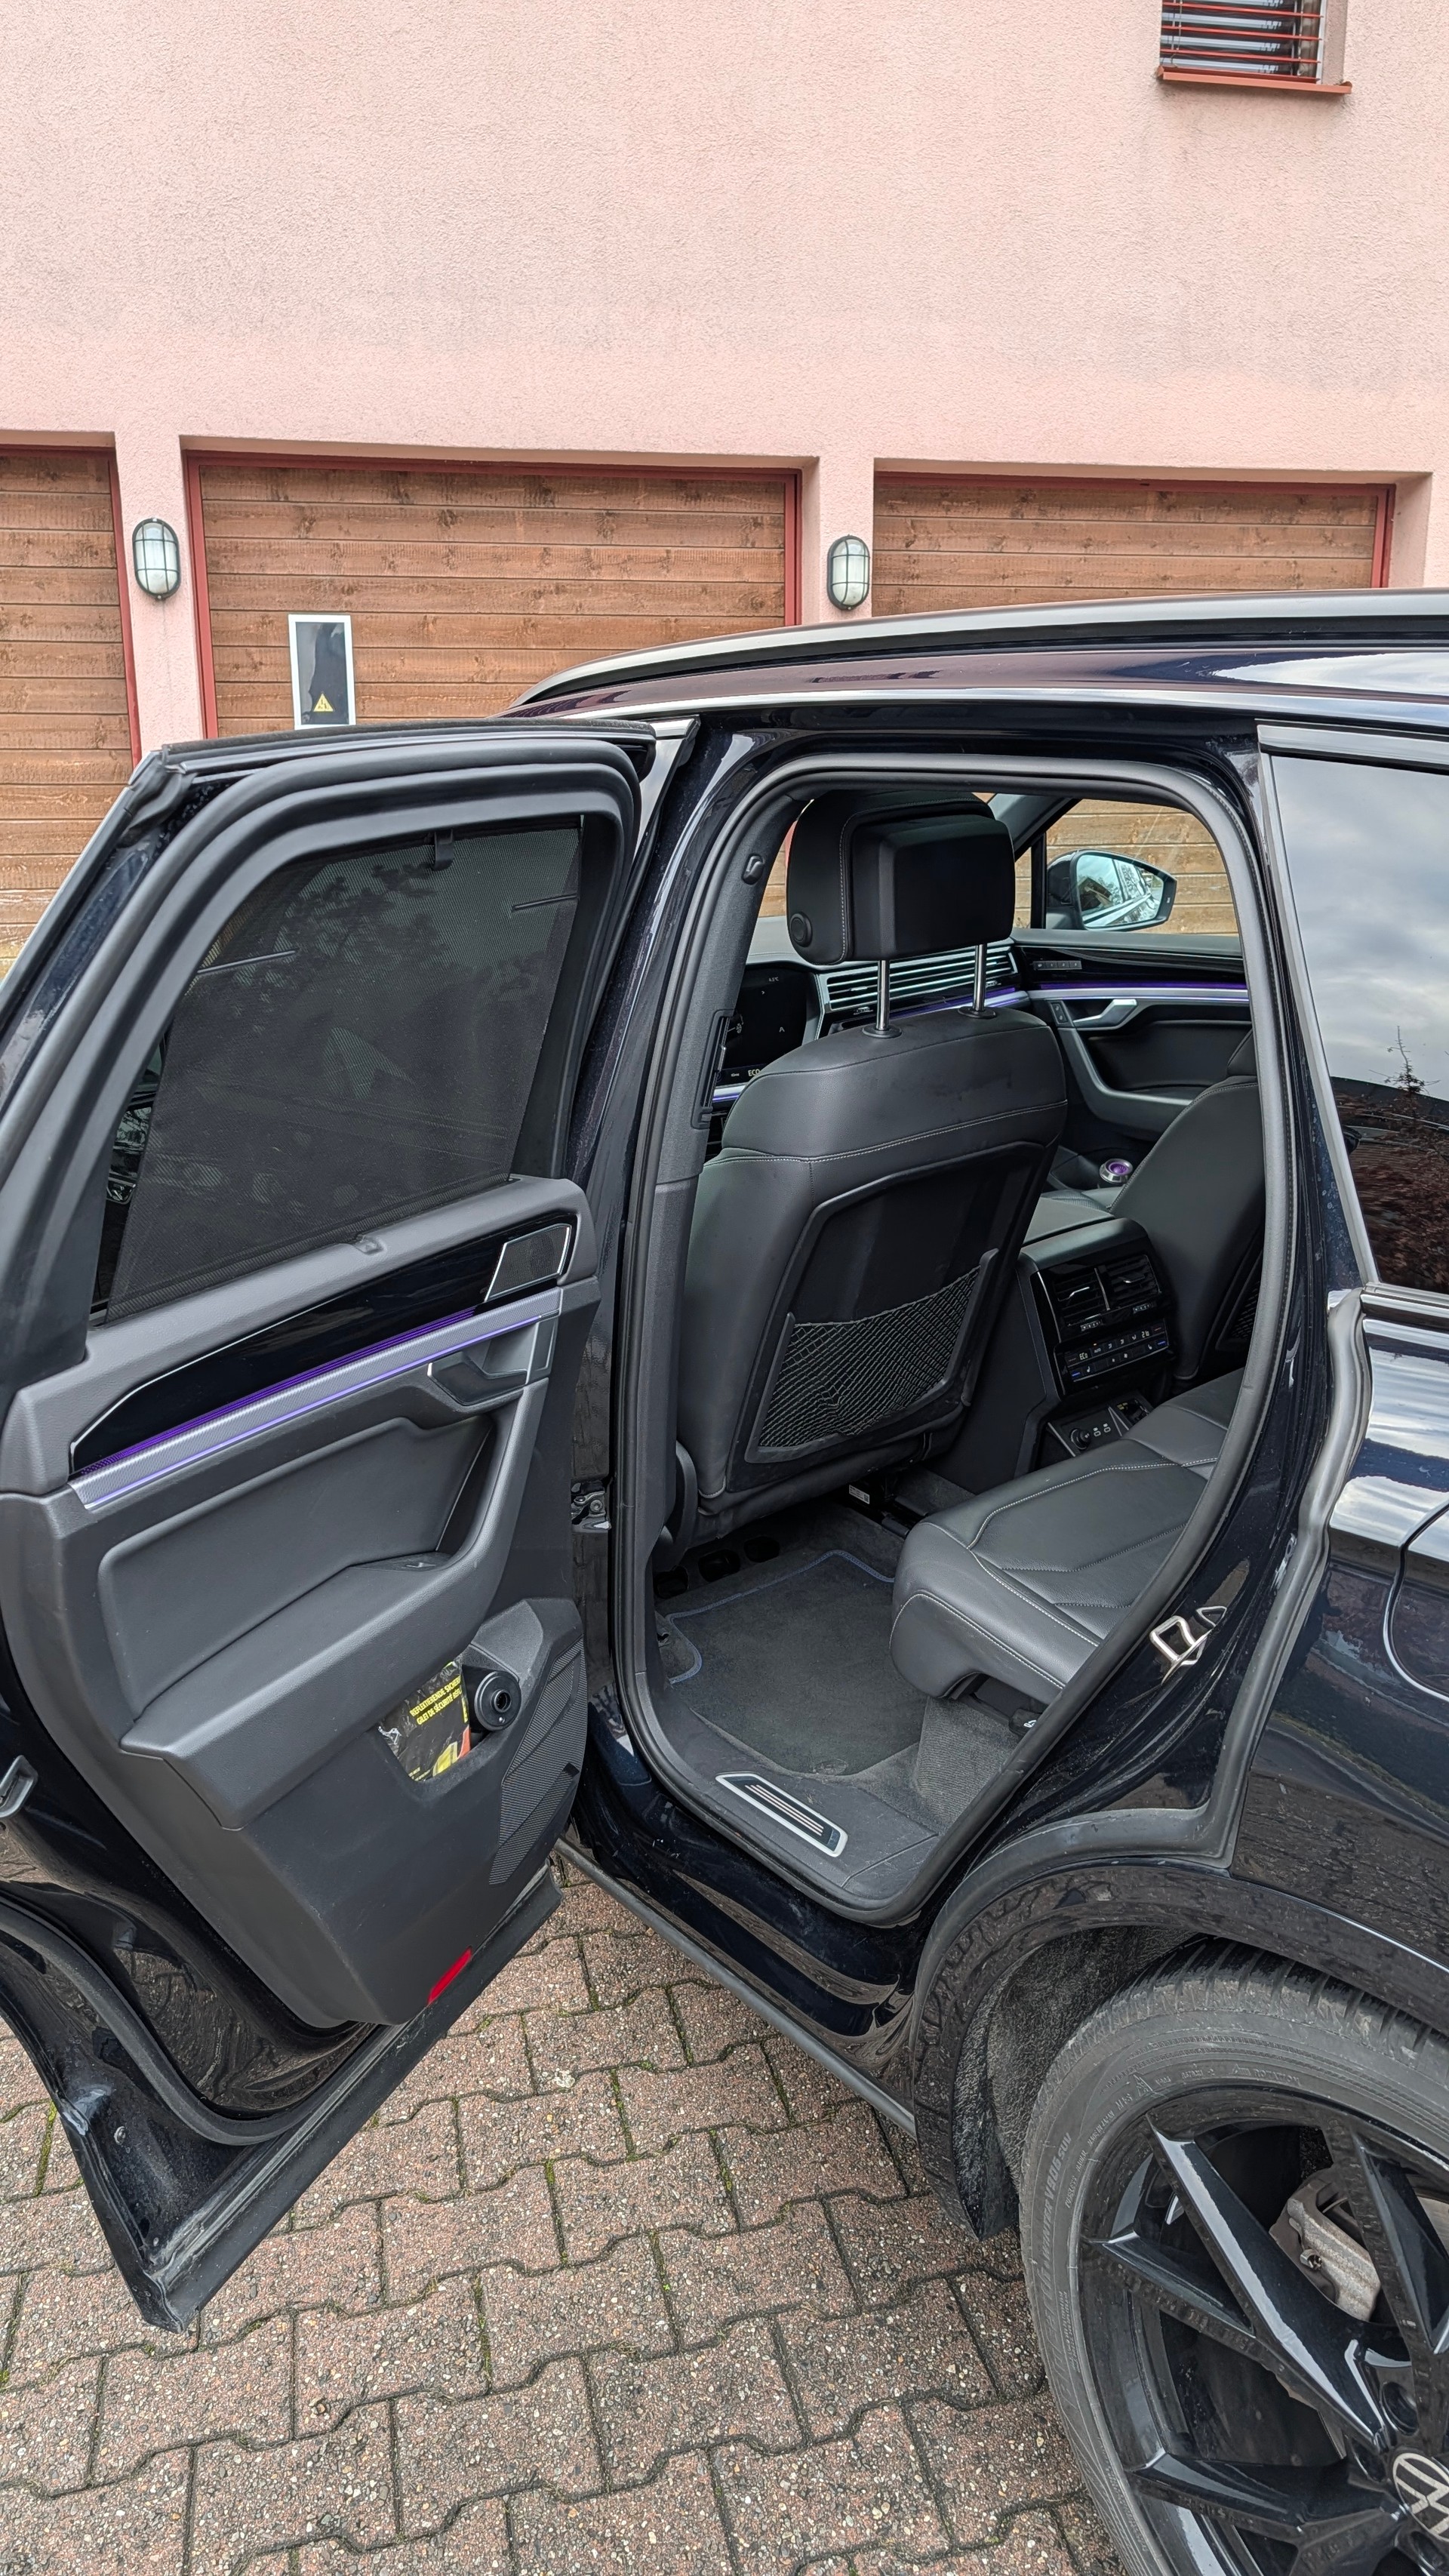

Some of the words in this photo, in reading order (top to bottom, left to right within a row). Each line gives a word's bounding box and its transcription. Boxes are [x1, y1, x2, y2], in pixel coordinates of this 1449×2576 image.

[427, 1707, 435, 1717] DE
[1057, 2131, 1072, 2160] SUV
[1044, 2156, 1063, 2199] V906
[1041, 2199, 1054, 2260] WINTER
